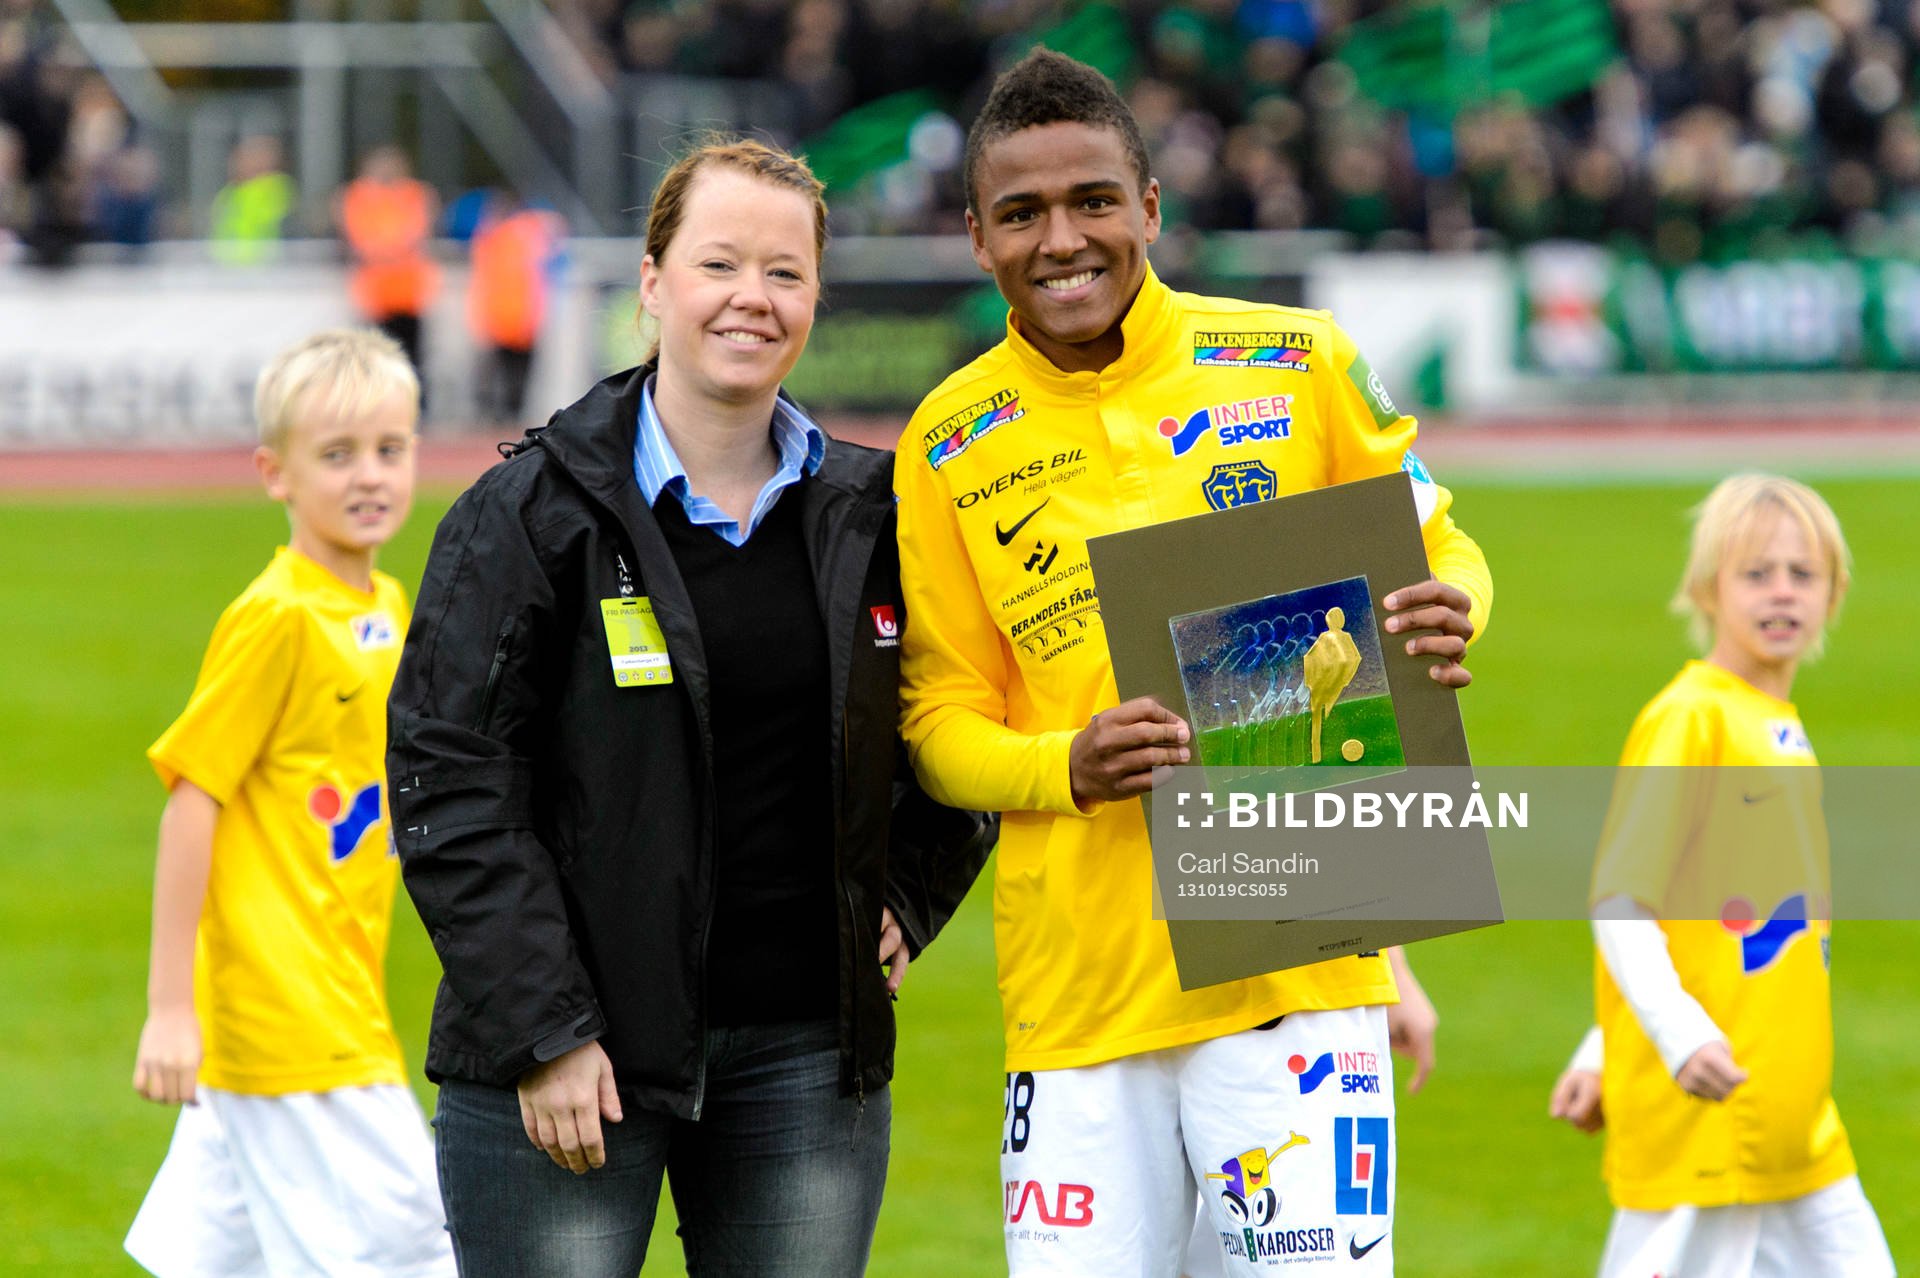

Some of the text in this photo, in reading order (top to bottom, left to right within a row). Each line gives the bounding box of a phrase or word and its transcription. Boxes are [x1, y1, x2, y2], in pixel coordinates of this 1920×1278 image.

[1195, 332, 1312, 351] FALKENBERGS LAX
[1294, 362, 1308, 371] AB
[925, 388, 1019, 452] ALKENBERGS LAX
[1011, 408, 1025, 421] AB
[1214, 396, 1288, 426] INTER
[1219, 417, 1291, 446] SPORT
[1050, 448, 1087, 469] BIL
[1023, 465, 1087, 496] Hela vägen
[1002, 561, 1092, 610] HANNELLSHOLDIN
[620, 607, 652, 616] PASSAG
[1011, 598, 1067, 638] BERANDERS
[1338, 1052, 1378, 1073] INTER
[1341, 1074, 1381, 1094] SPORT
[1034, 1230, 1060, 1243] tryck
[1256, 1228, 1335, 1257] KAROSSER
